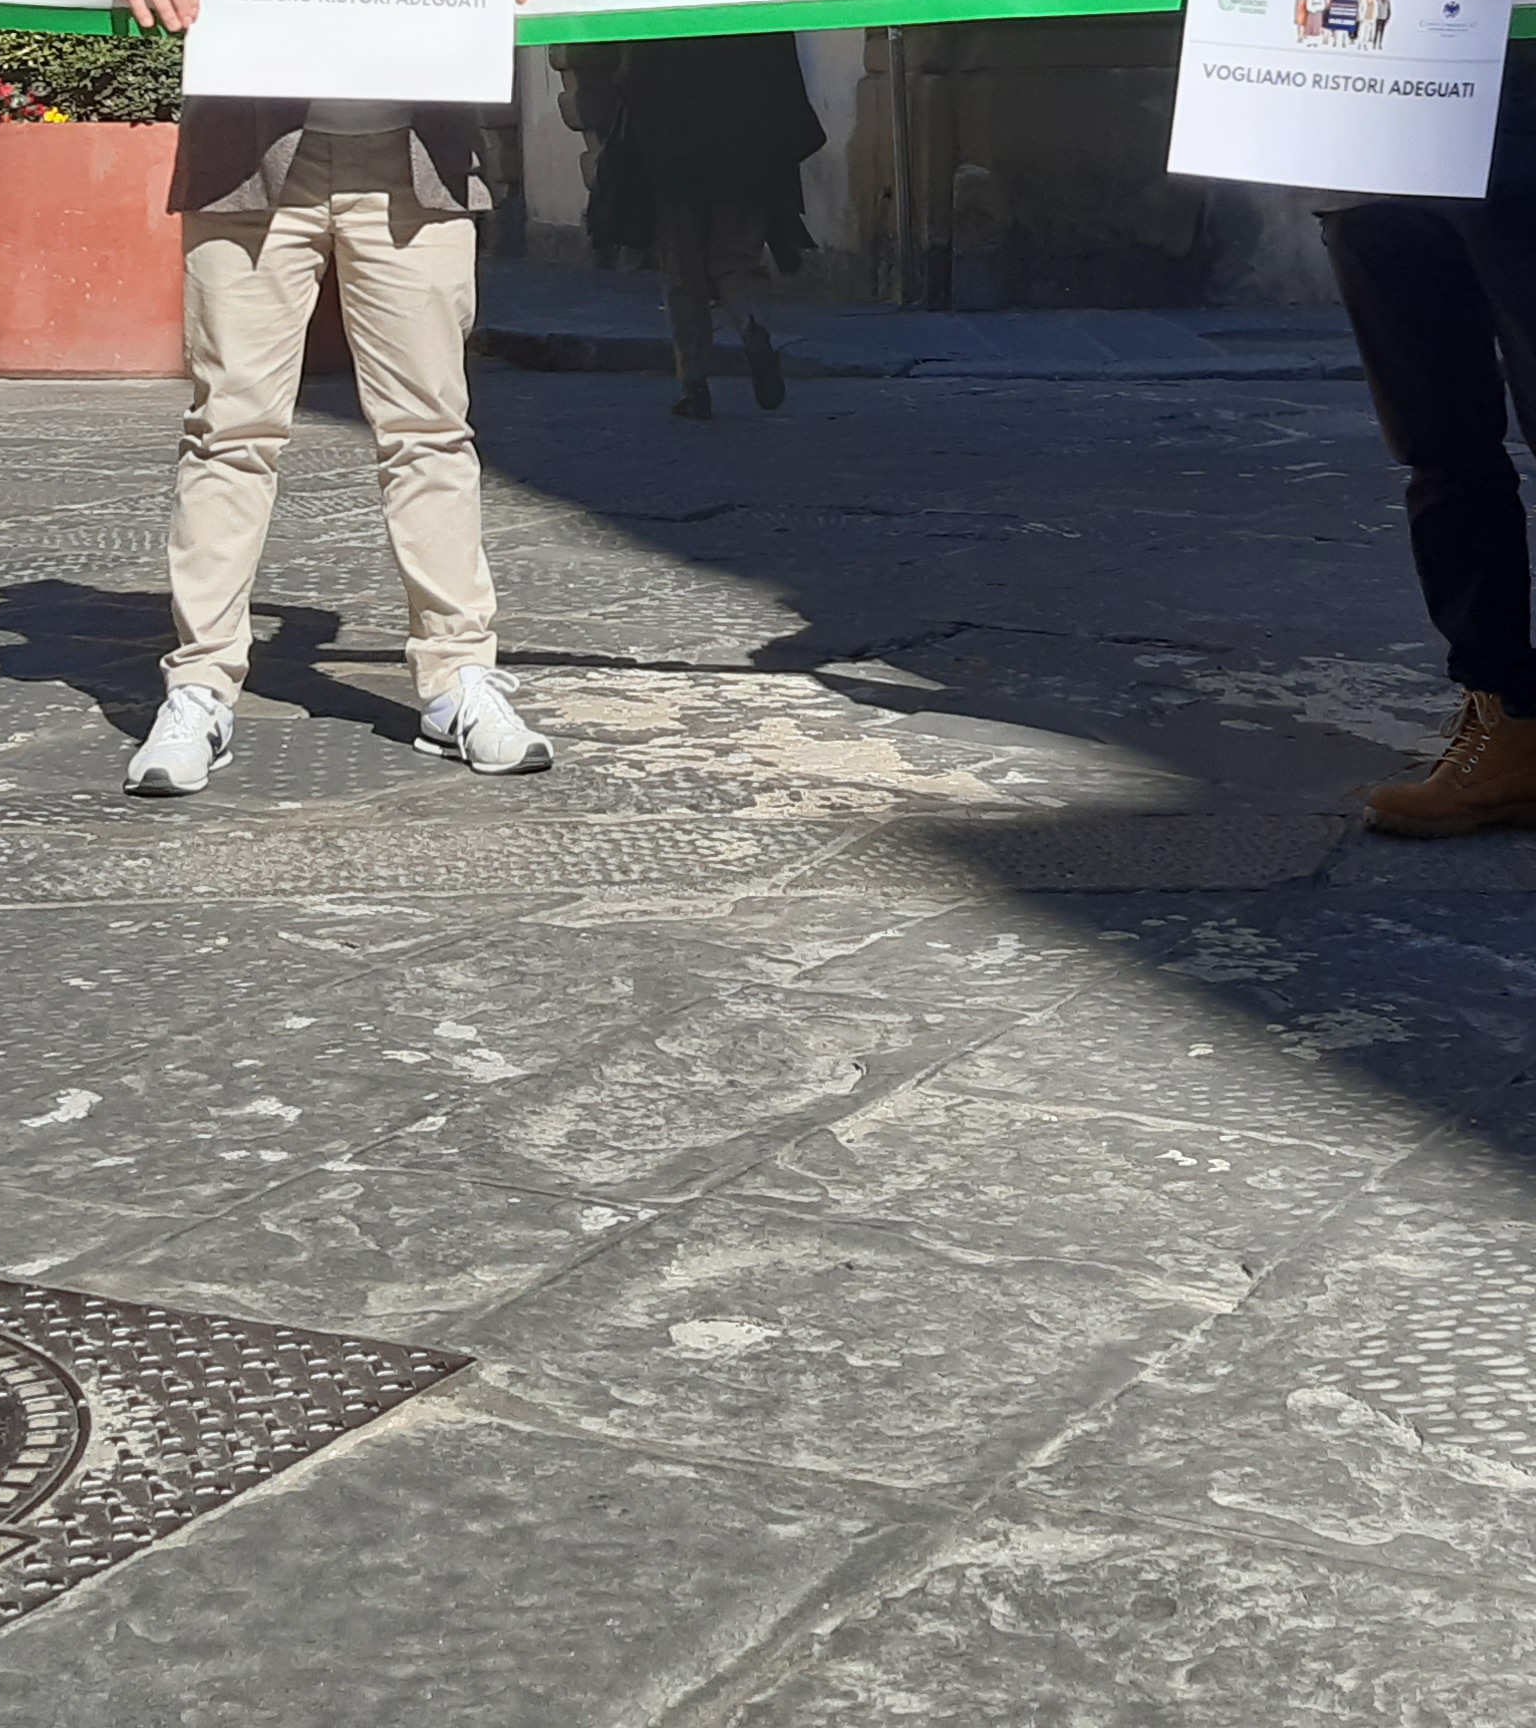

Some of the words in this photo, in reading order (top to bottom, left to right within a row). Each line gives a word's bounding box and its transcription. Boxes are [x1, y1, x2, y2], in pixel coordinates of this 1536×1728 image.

[1202, 62, 1306, 88] VOGLIAMO
[1312, 73, 1385, 95] RISTORI
[1388, 79, 1475, 99] ADEGUATI
